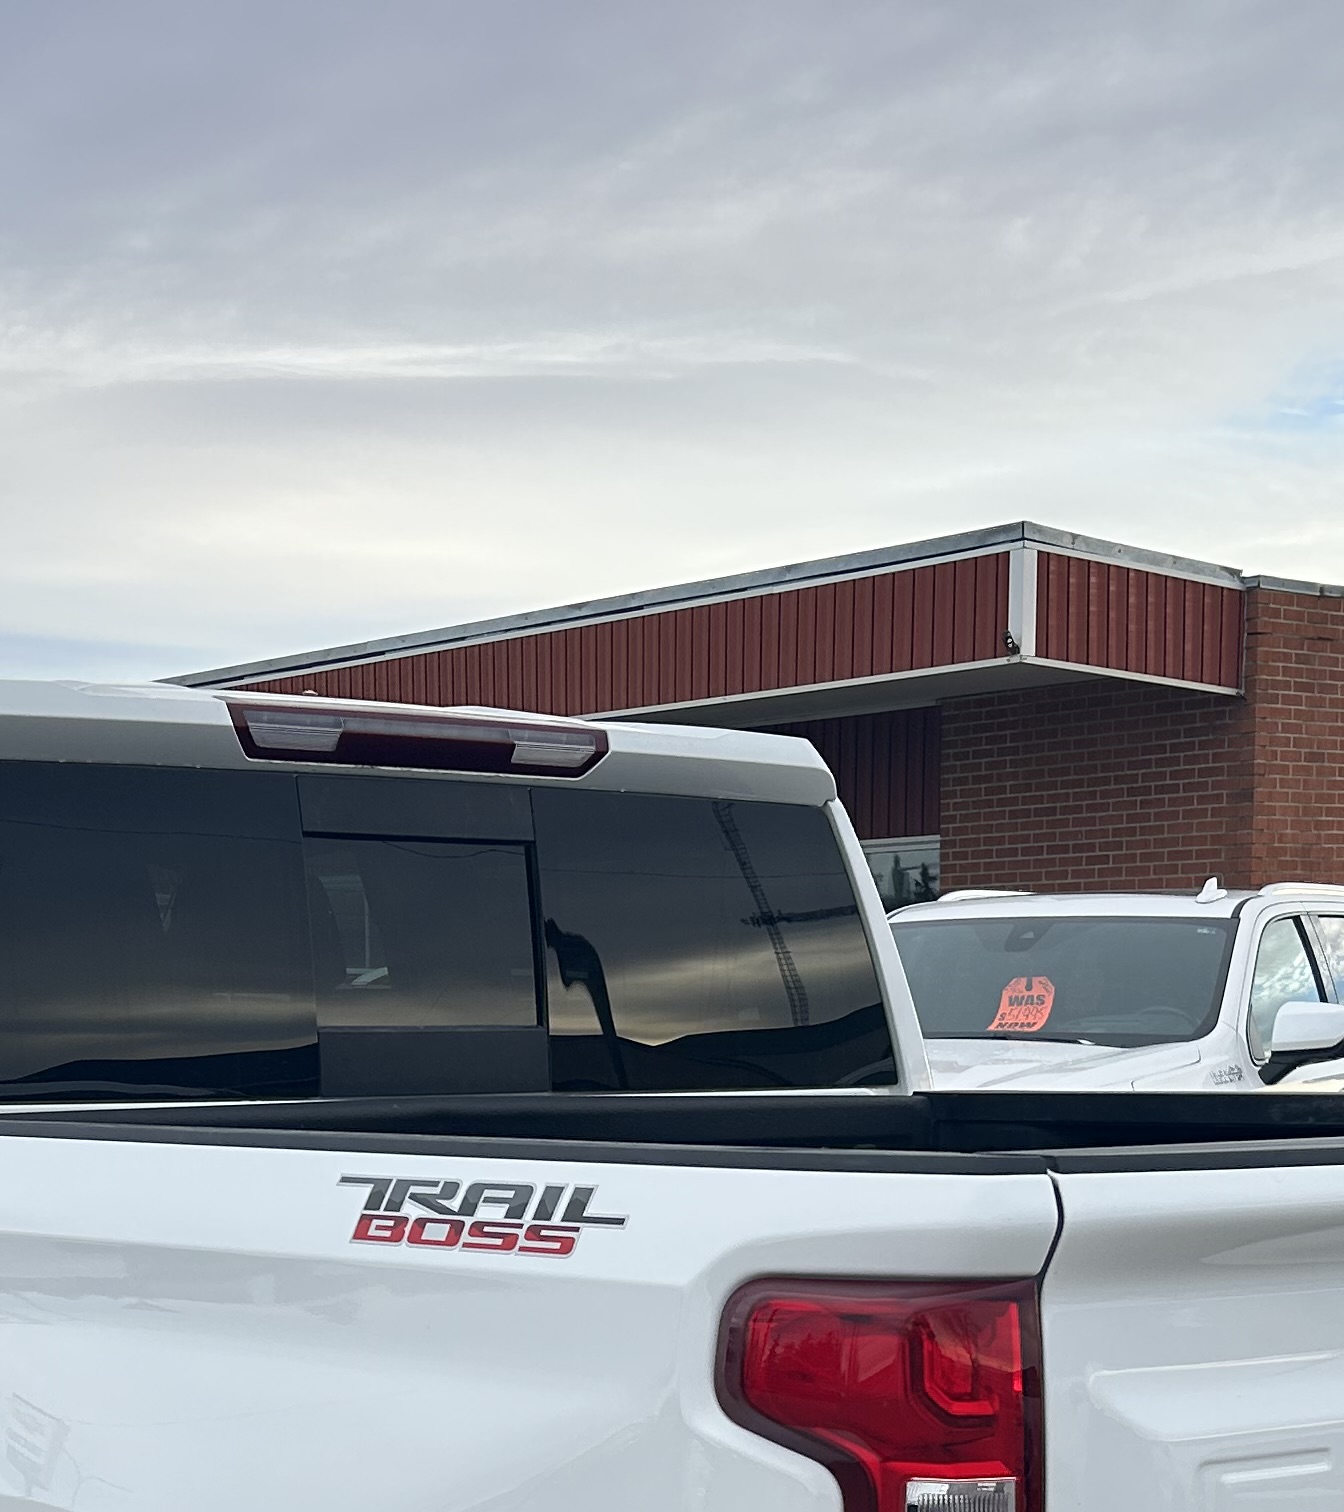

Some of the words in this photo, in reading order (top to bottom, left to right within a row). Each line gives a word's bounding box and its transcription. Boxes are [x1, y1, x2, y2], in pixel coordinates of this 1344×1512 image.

[1008, 994, 1046, 1007] WAS
[336, 1173, 630, 1227] TRAIL
[350, 1212, 585, 1259] BOSS
